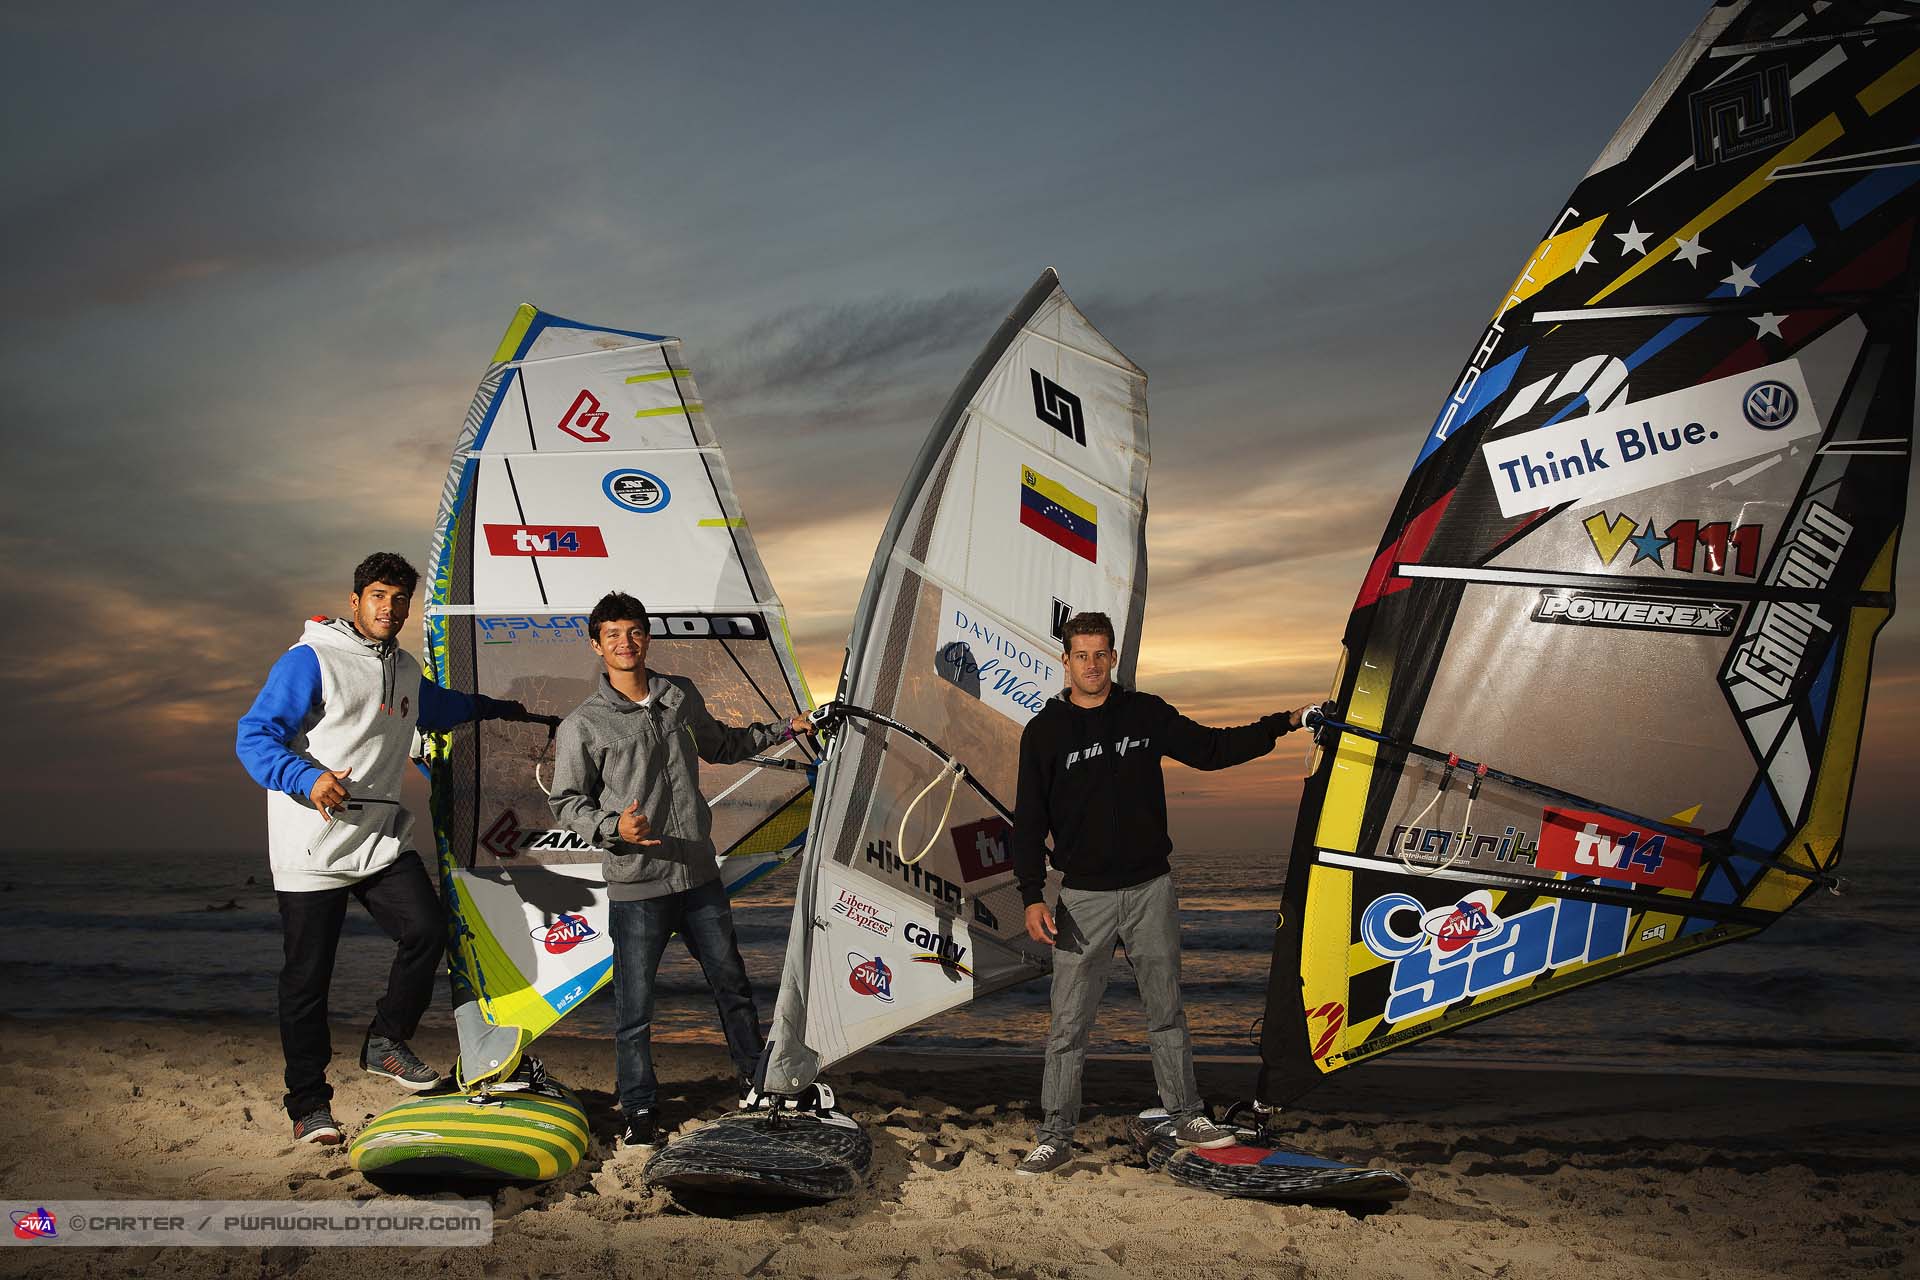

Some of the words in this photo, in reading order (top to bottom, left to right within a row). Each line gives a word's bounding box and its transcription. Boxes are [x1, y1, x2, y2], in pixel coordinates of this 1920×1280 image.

[1499, 438, 1610, 493] Think
[1616, 420, 1719, 463] Blue.
[512, 529, 581, 552] tv14
[1540, 595, 1734, 631] POWEREX
[955, 610, 1056, 681] DAVIDOFF
[992, 668, 1046, 714] Wate
[1574, 822, 1668, 875] tv14
[838, 889, 880, 917] Liberty
[547, 922, 588, 947] PWA
[845, 906, 890, 935] Express
[1442, 911, 1485, 942] PWA
[855, 967, 888, 991] PWA
